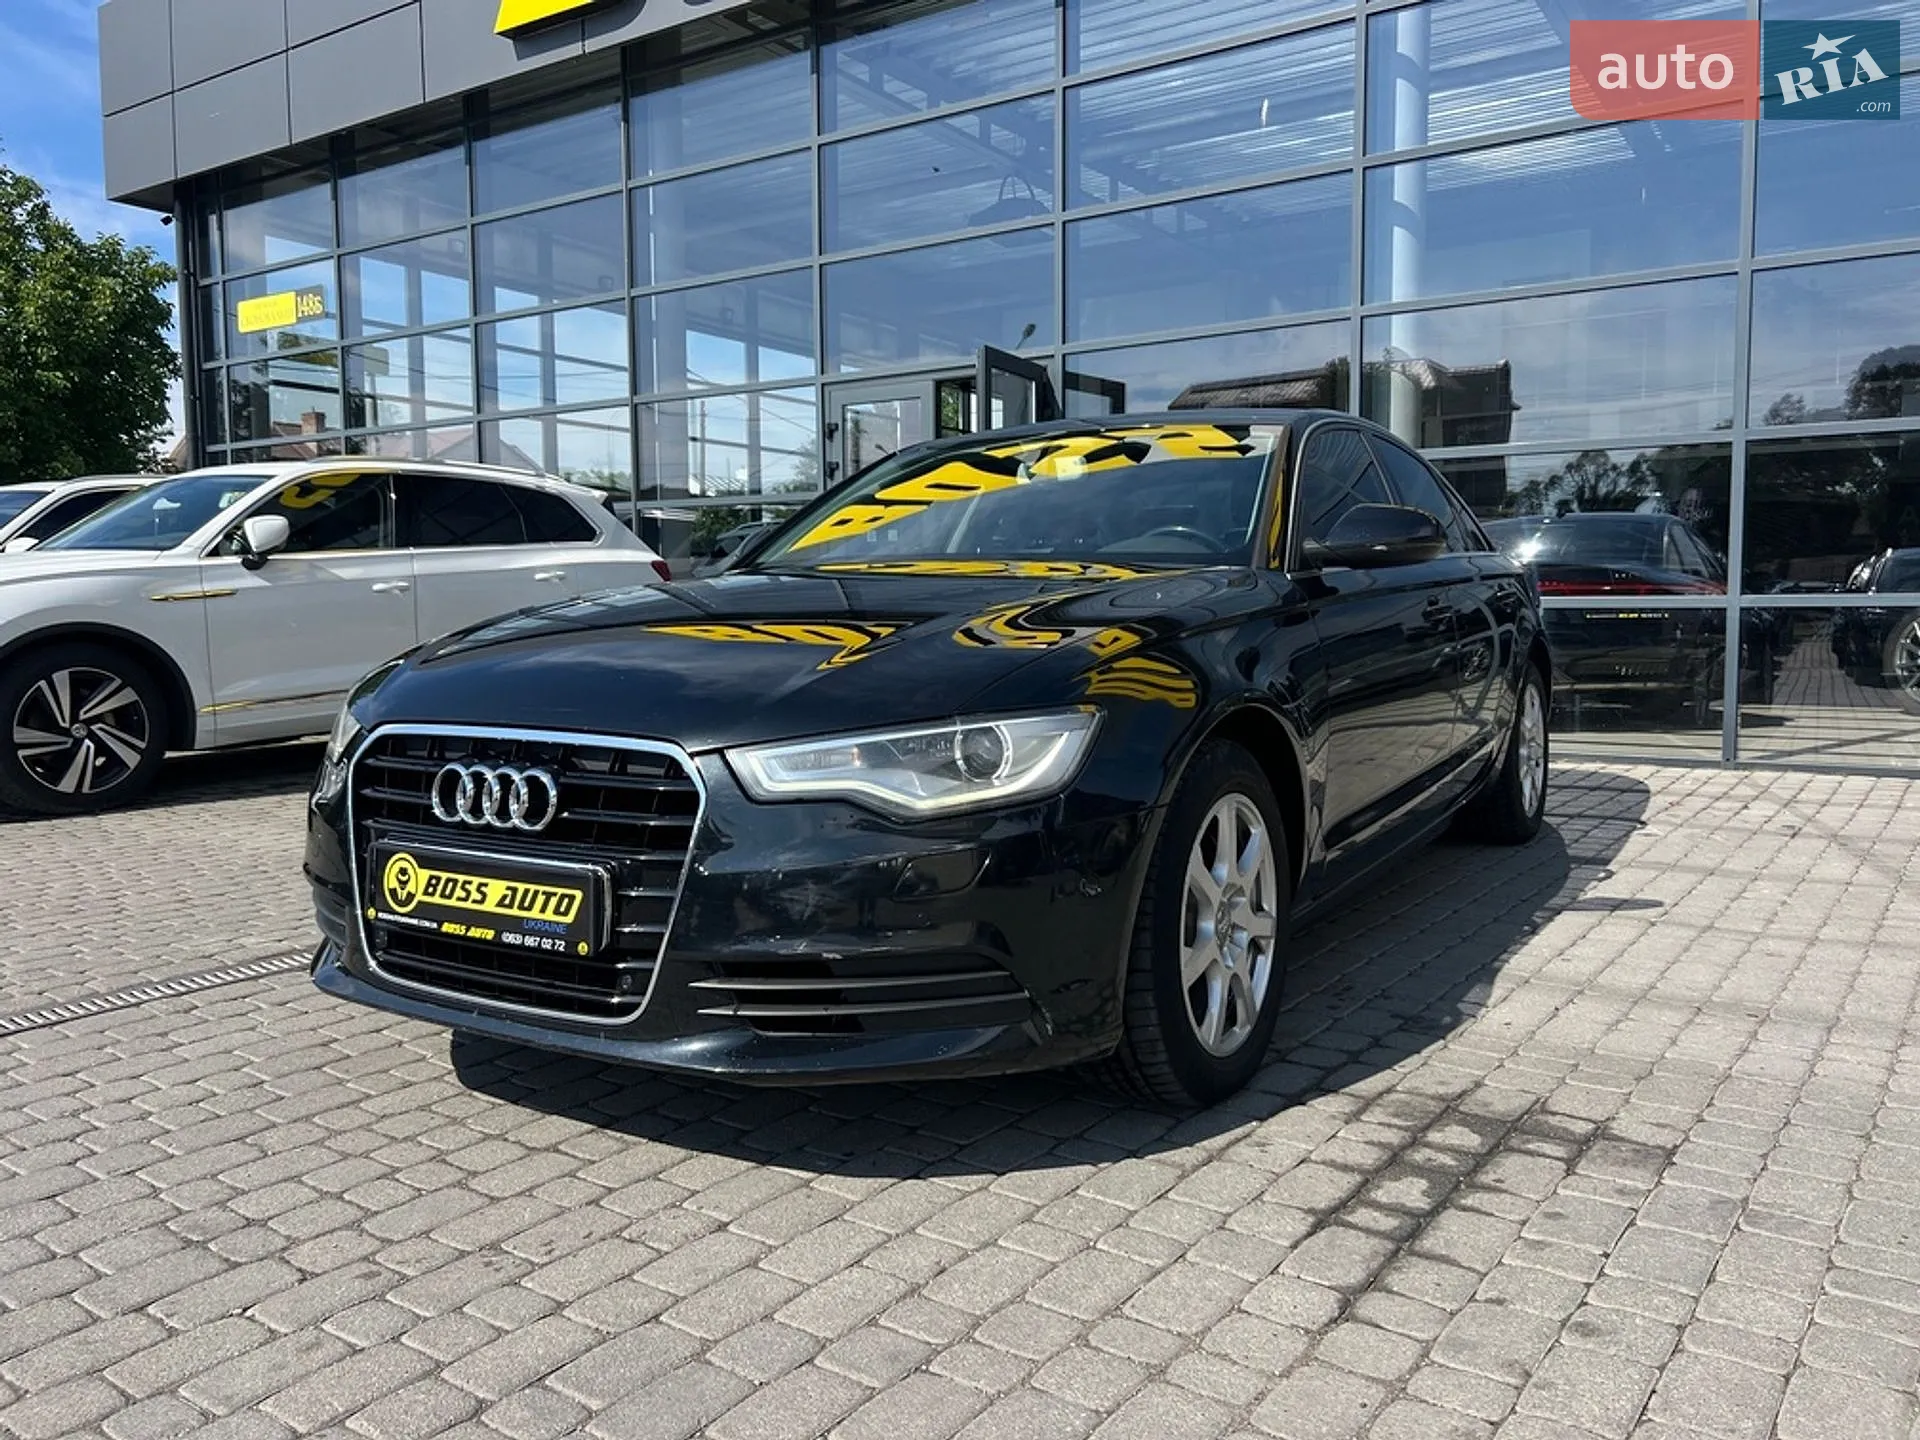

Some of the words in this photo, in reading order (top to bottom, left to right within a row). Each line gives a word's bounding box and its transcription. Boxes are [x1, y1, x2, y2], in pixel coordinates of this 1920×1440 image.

[422, 874, 490, 905] BOSS
[495, 885, 577, 918] AUTO
[441, 922, 466, 935] BOSS
[554, 939, 566, 951] 72
[523, 919, 567, 934] UKRAINE
